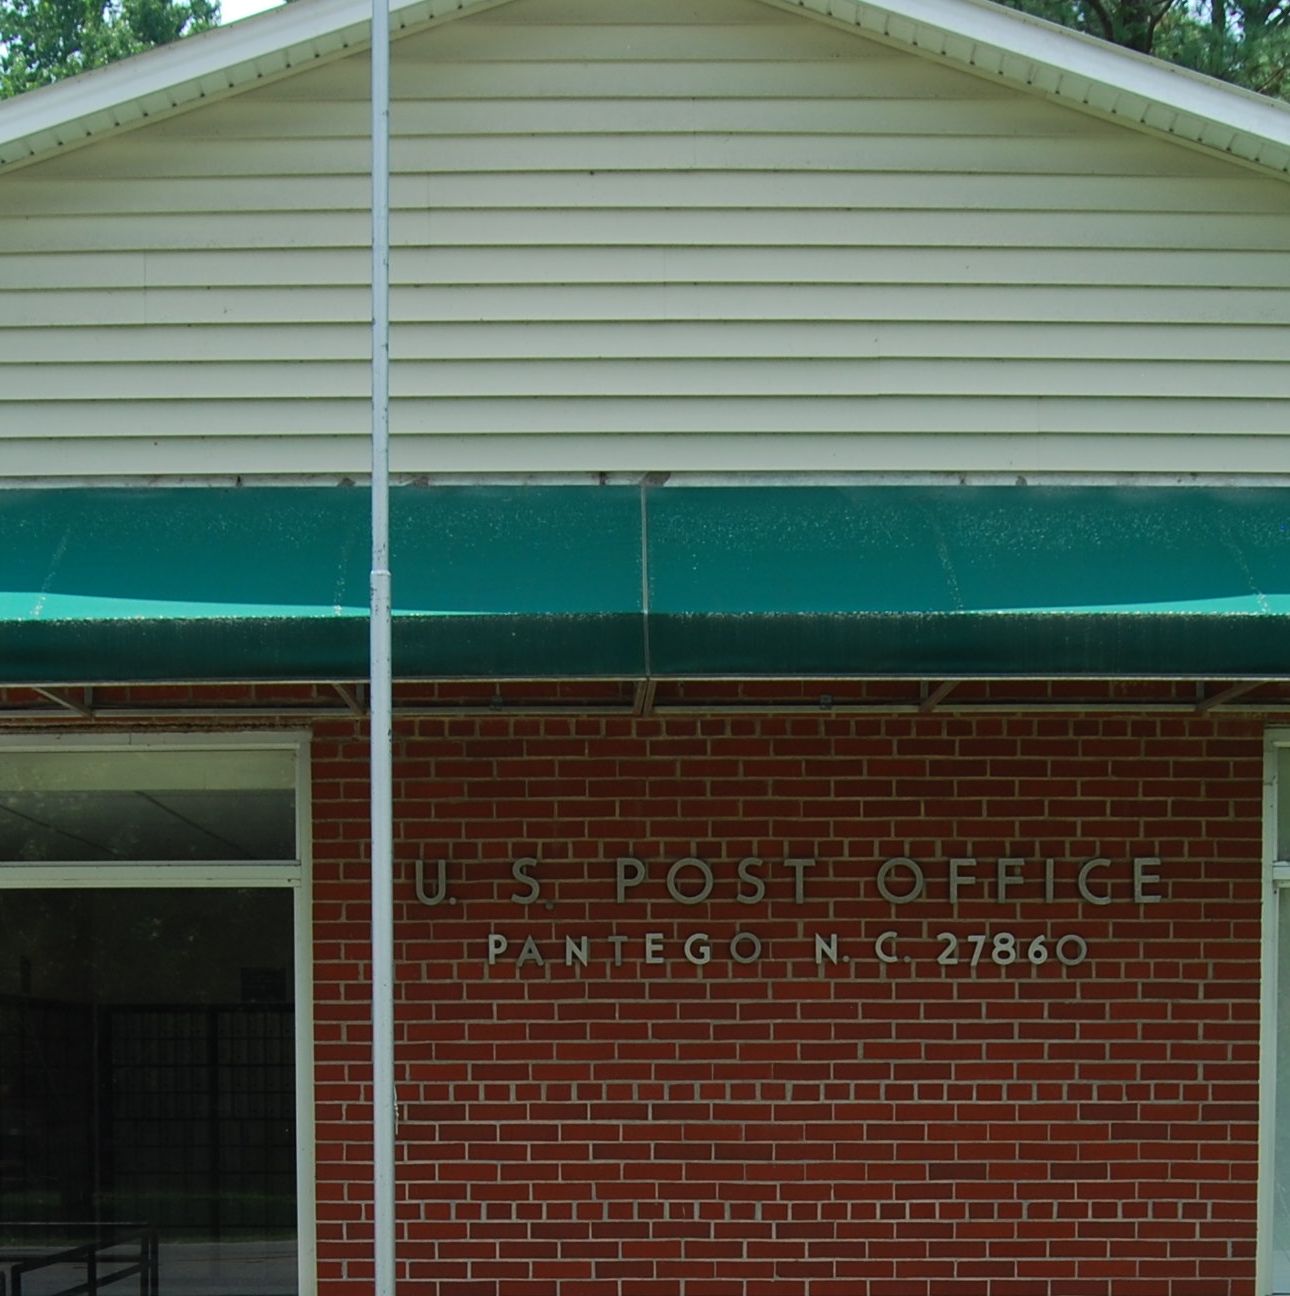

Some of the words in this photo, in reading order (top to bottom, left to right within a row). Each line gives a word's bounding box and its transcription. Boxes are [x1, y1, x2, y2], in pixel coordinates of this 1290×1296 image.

[616, 857, 817, 905] POST
[876, 857, 1163, 906] OFFICE
[487, 932, 763, 967] PANTEGO
[936, 932, 1088, 967] 27860
